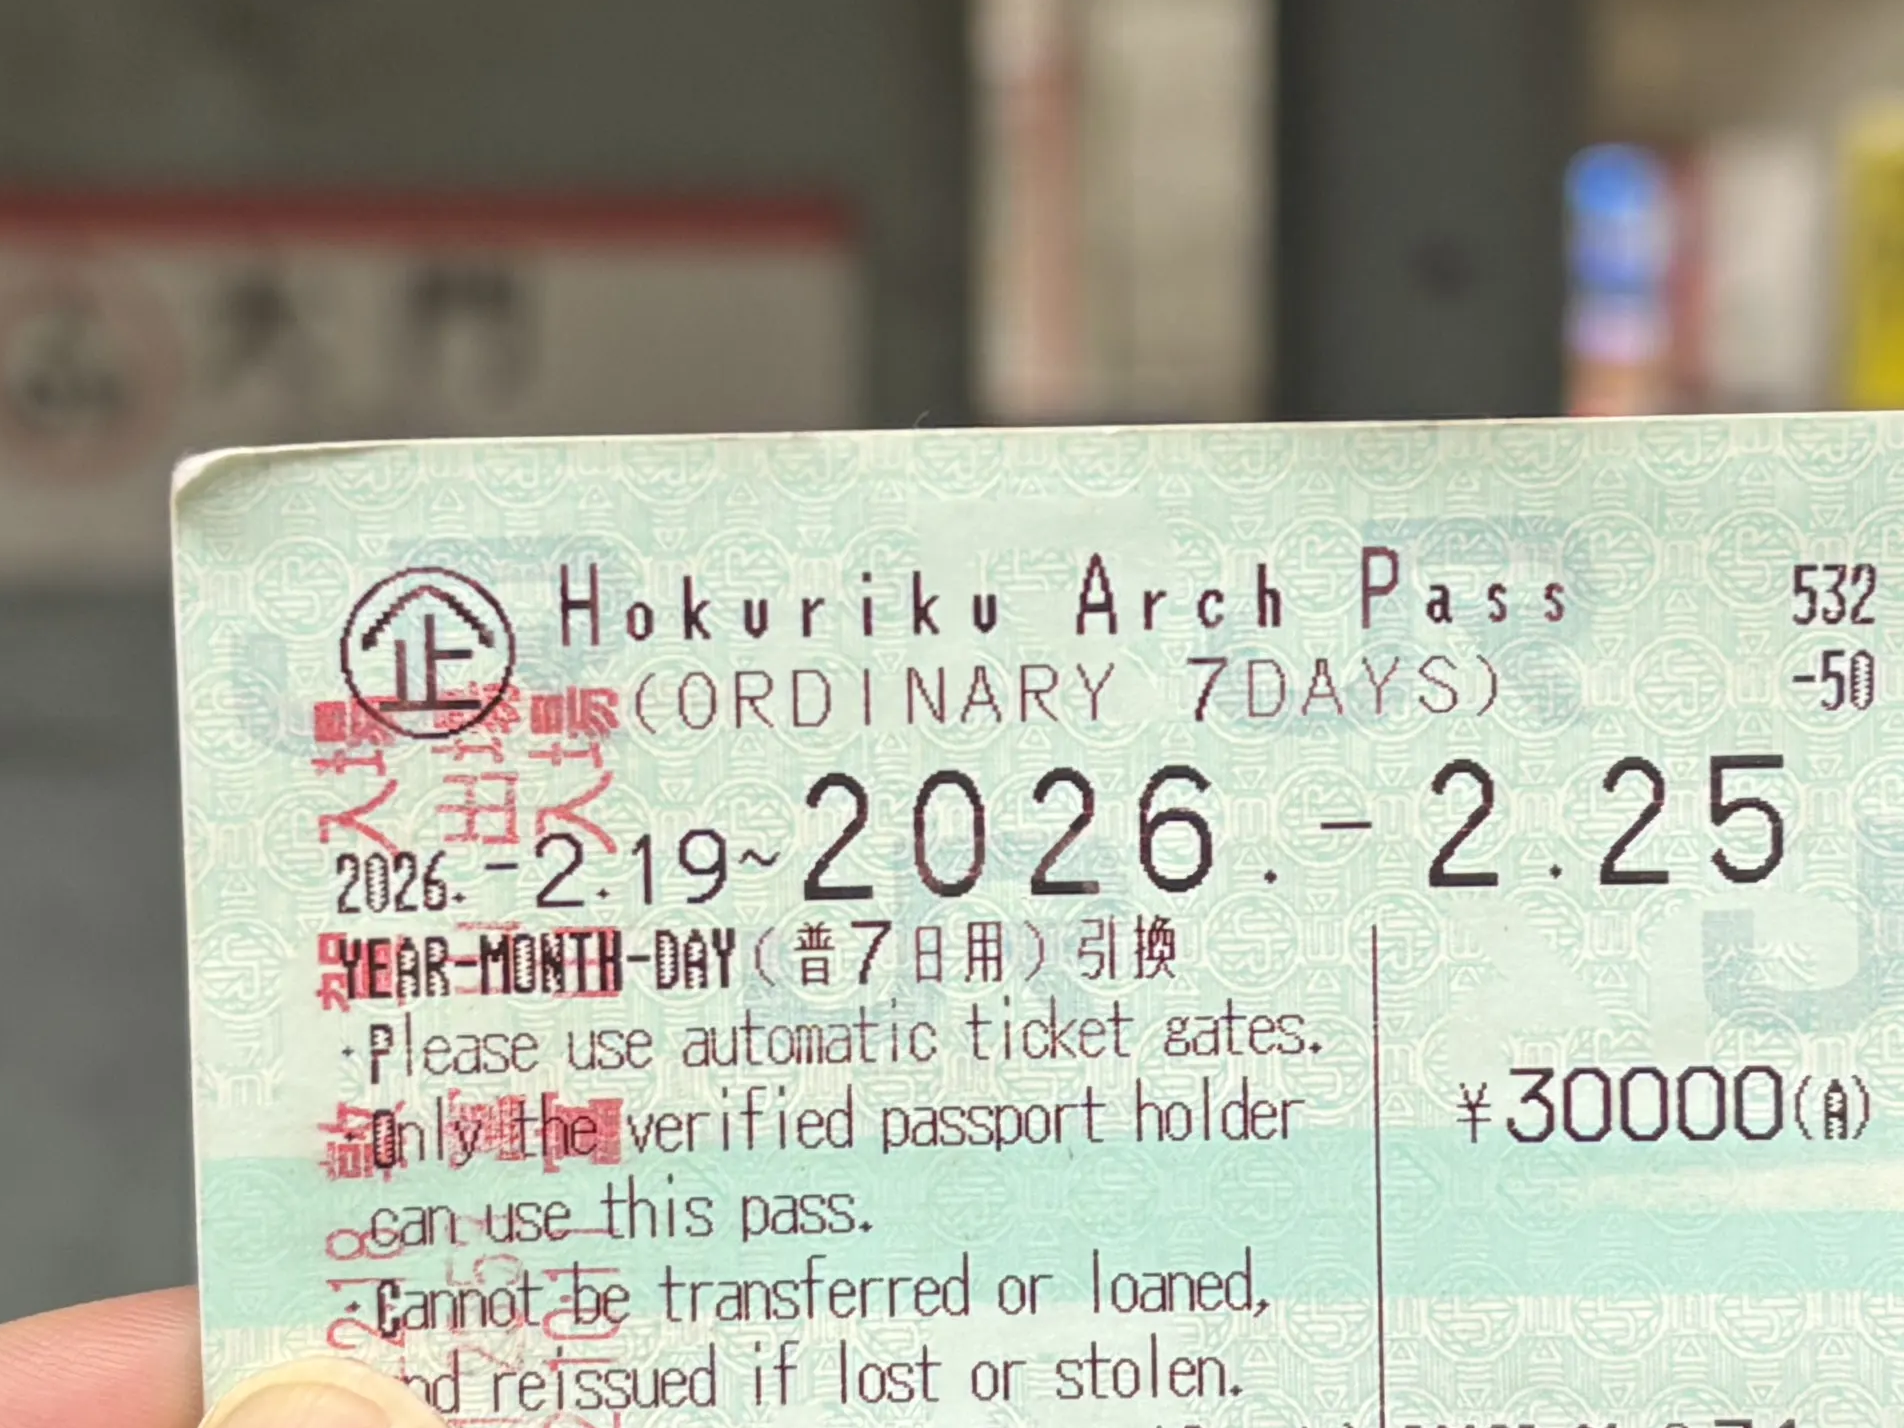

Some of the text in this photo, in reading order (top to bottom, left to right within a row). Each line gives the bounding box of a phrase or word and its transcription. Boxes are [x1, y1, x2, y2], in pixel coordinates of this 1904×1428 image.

[559, 544, 1568, 648] Hokuriku Arch Pass
[1790, 562, 1877, 627] 532
[635, 653, 1501, 734] (ORDINARY 7DAYS)
[1792, 649, 1876, 711] -50
[336, 926, 737, 999] YEAR-MONTH-DAY
[566, 1028, 654, 1071] use
[681, 1006, 938, 1069] automatic
[964, 996, 1132, 1061] ticket
[1162, 996, 1324, 1059] gates.
[512, 1092, 600, 1156] the
[625, 1082, 855, 1155] verified
[880, 1084, 1104, 1156] passport
[1134, 1075, 1305, 1143] holder
[369, 1174, 875, 1249] can use this pass.
[572, 1259, 631, 1327] be
[663, 1250, 972, 1322] transferred
[997, 1269, 1055, 1316] or
[1093, 1244, 1272, 1320] loaned,
[404, 1332, 1244, 1416] nd reissued if lost or stolen.
